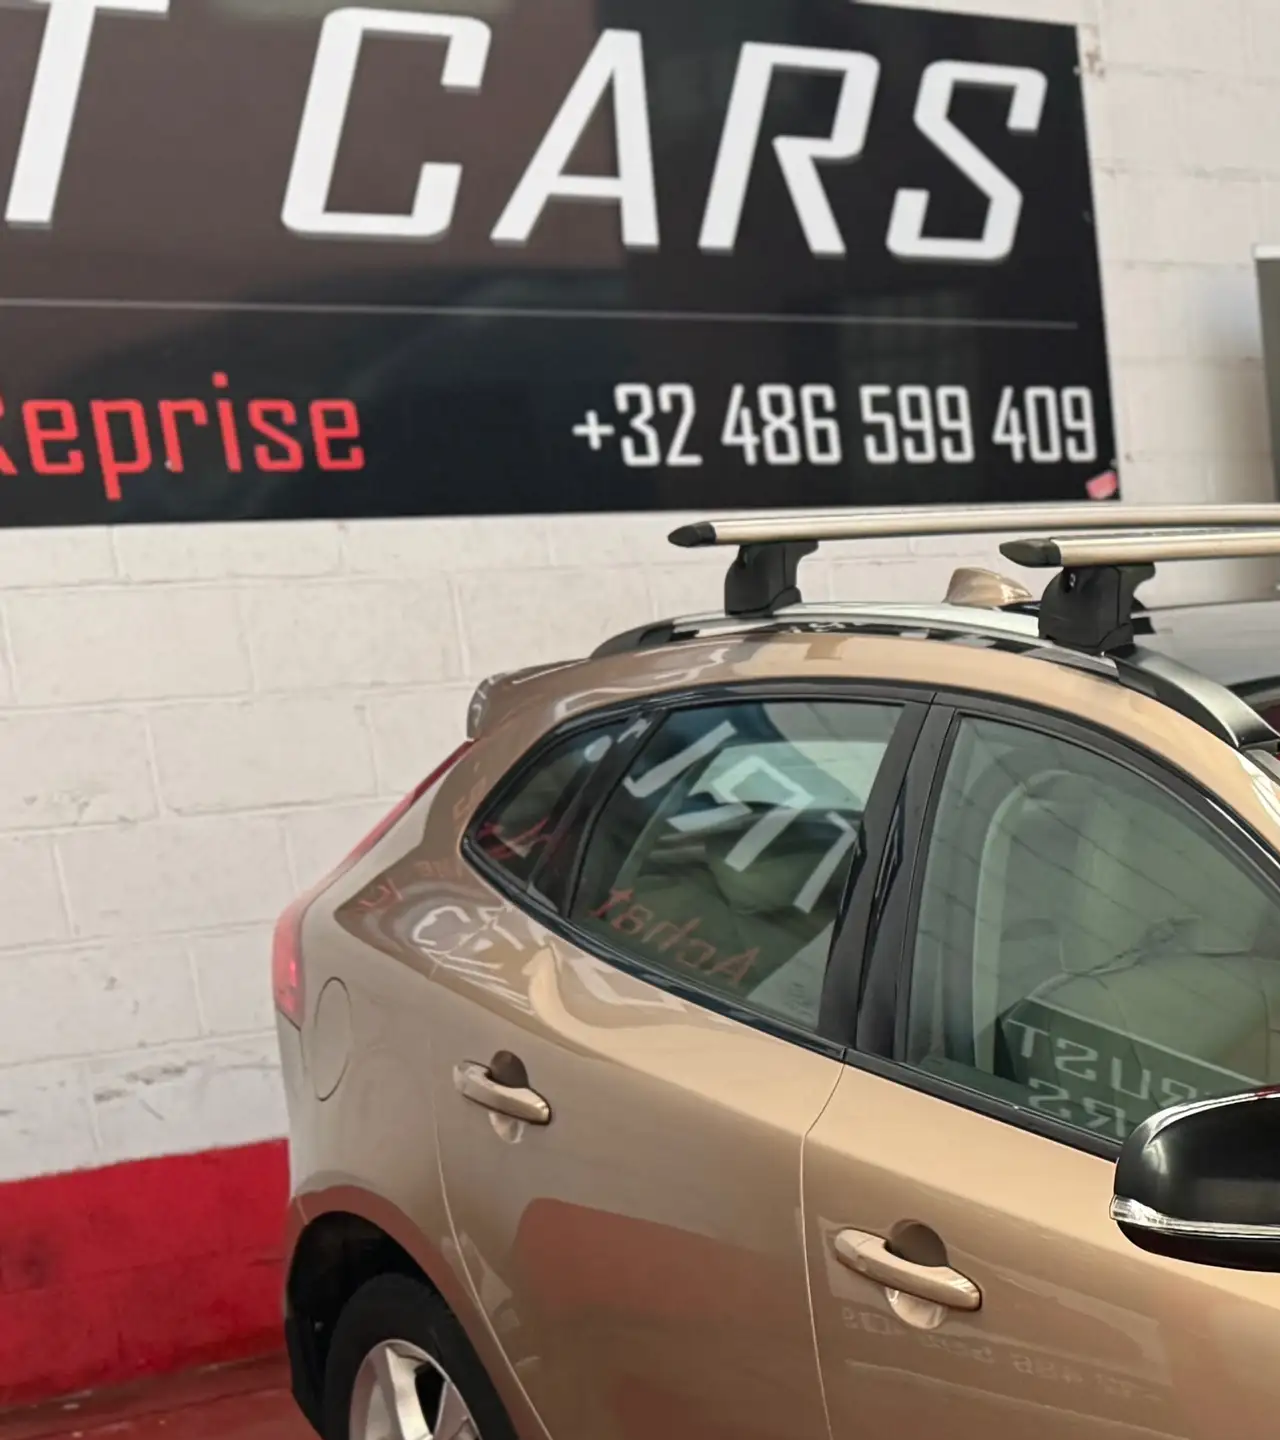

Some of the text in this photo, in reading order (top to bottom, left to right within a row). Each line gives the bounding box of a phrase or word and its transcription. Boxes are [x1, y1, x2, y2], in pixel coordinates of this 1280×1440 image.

[281, 7, 1048, 262] CARS
[572, 383, 703, 466] +32
[721, 384, 842, 465] 486
[859, 385, 975, 464] 599
[992, 386, 1098, 463] 409
